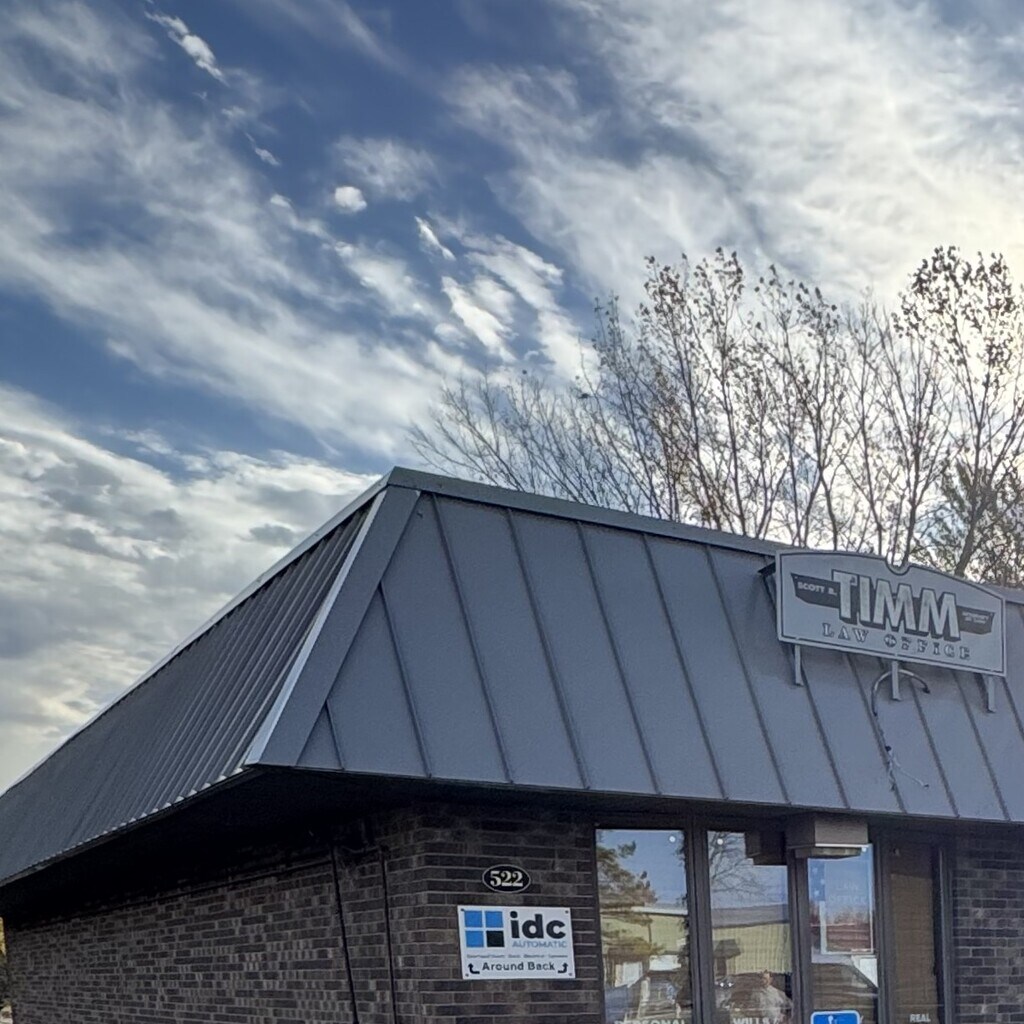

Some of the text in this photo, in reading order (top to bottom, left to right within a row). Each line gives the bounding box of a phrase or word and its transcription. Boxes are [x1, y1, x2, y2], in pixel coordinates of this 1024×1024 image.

[797, 581, 825, 593] SCOTT
[832, 569, 961, 641] TIMM
[822, 622, 971, 660] LAW OFFICE
[489, 870, 523, 887] 522
[509, 910, 566, 939] idc
[511, 940, 567, 949] AUTOMATIC
[481, 962, 555, 971] Around Back
[909, 1013, 931, 1023] REAL
